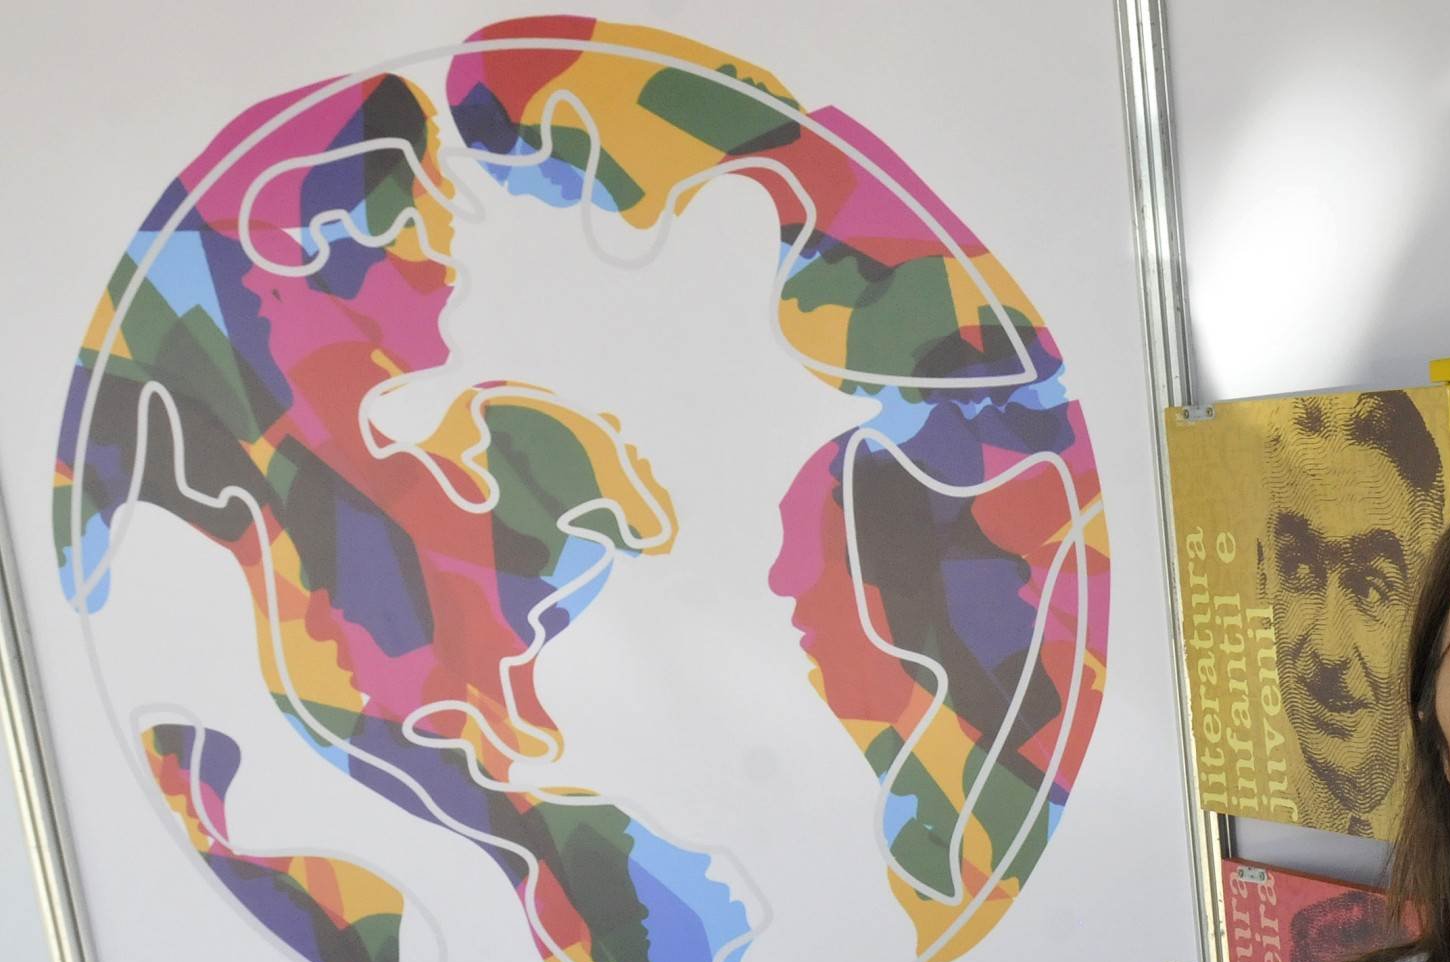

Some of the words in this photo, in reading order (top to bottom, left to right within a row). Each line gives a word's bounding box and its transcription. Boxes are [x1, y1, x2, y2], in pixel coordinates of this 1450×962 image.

[1216, 531, 1237, 564] e
[1186, 526, 1229, 809] literatura
[1214, 592, 1259, 813] infantil
[1245, 603, 1298, 821] juvenil
